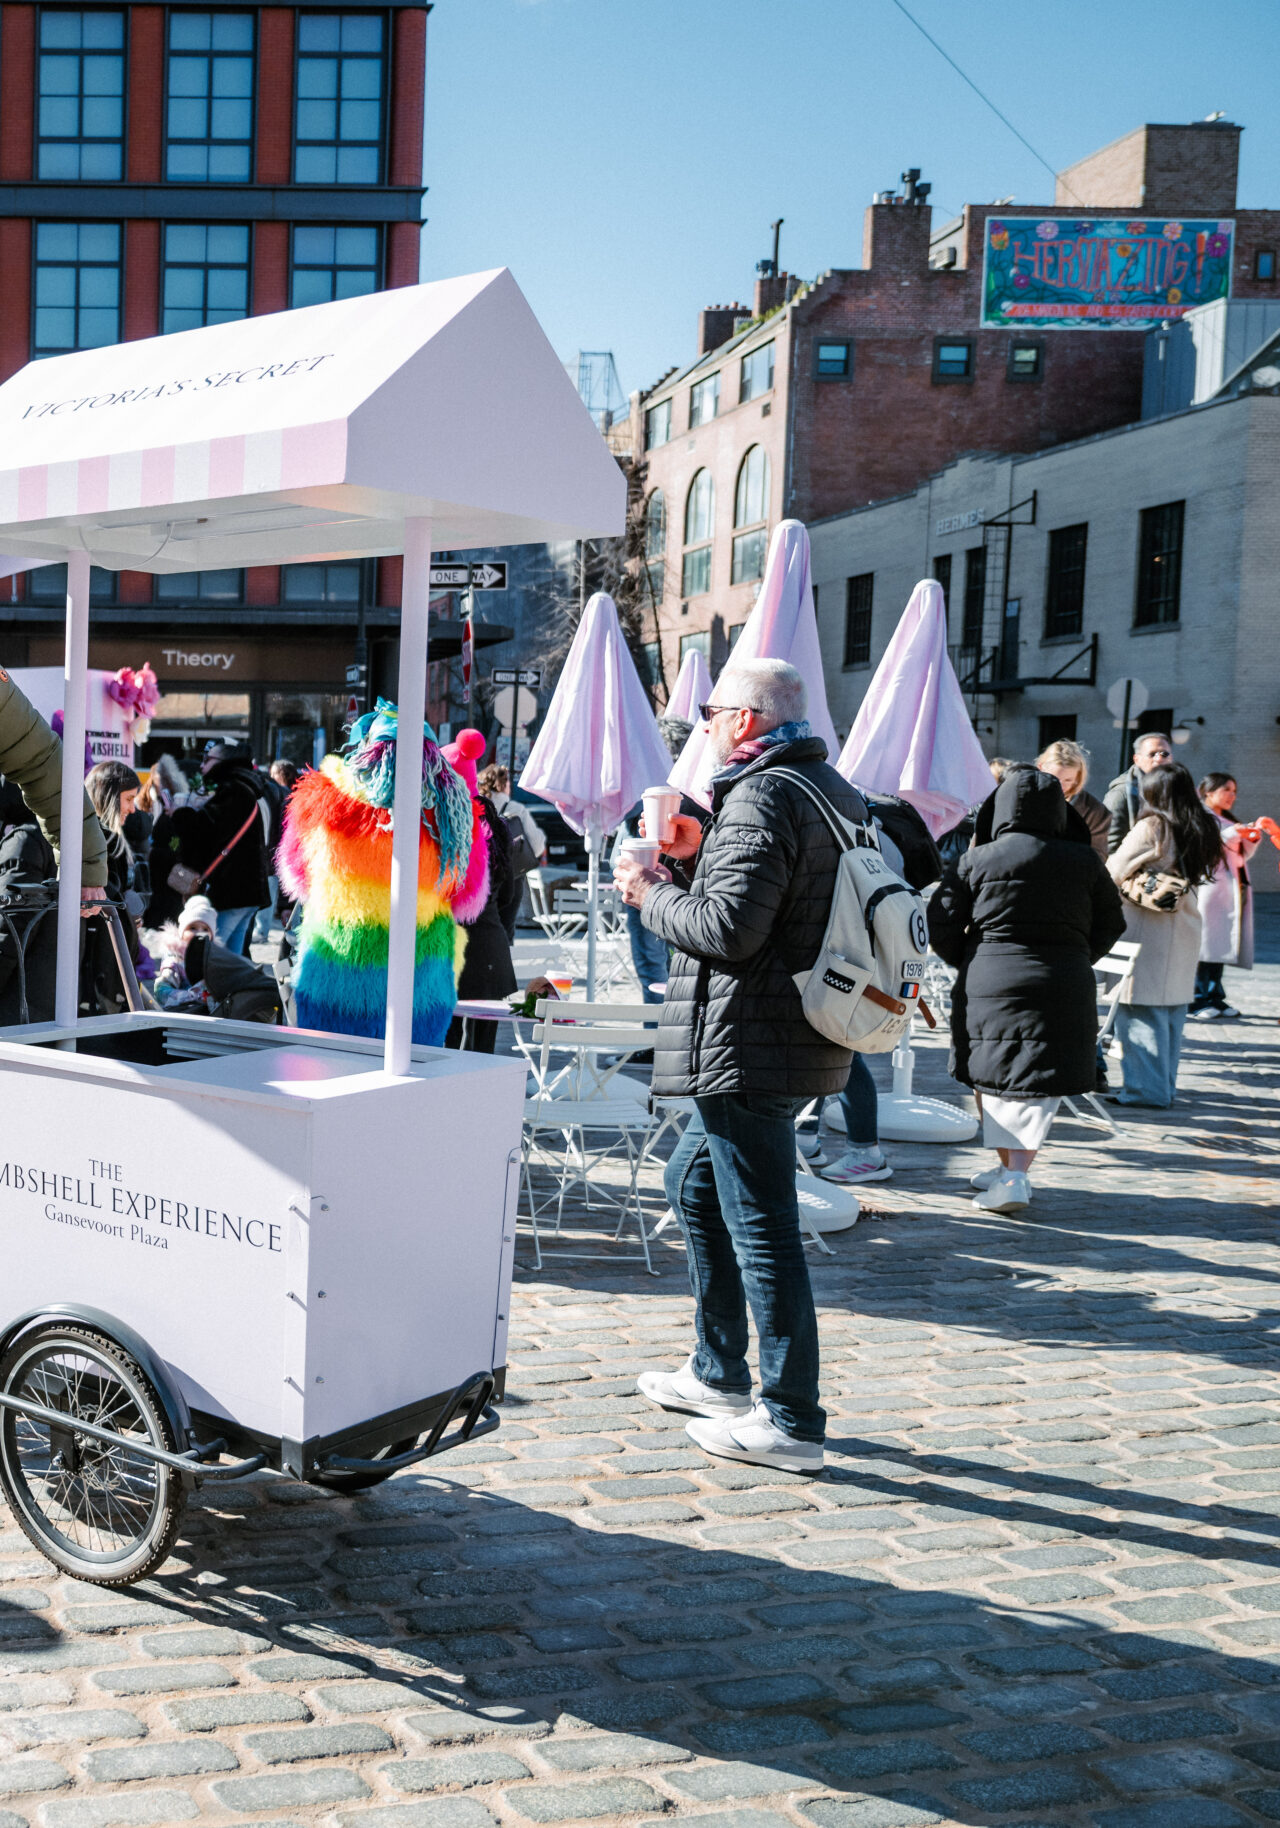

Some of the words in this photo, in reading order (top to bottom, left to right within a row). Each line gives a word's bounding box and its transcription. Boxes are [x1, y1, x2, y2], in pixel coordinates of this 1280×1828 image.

[22, 380, 192, 420] VICTORIA'S
[194, 354, 334, 391] SECRET
[435, 571, 459, 582] ONE
[161, 649, 236, 670] Theory
[916, 914, 927, 947] 8
[905, 963, 923, 977] 1978
[88, 1158, 123, 1182] THE
[44, 1203, 125, 1239] Gansevoort
[130, 1223, 169, 1250] Plaza
[111, 1187, 282, 1253] EXPERIENCE
